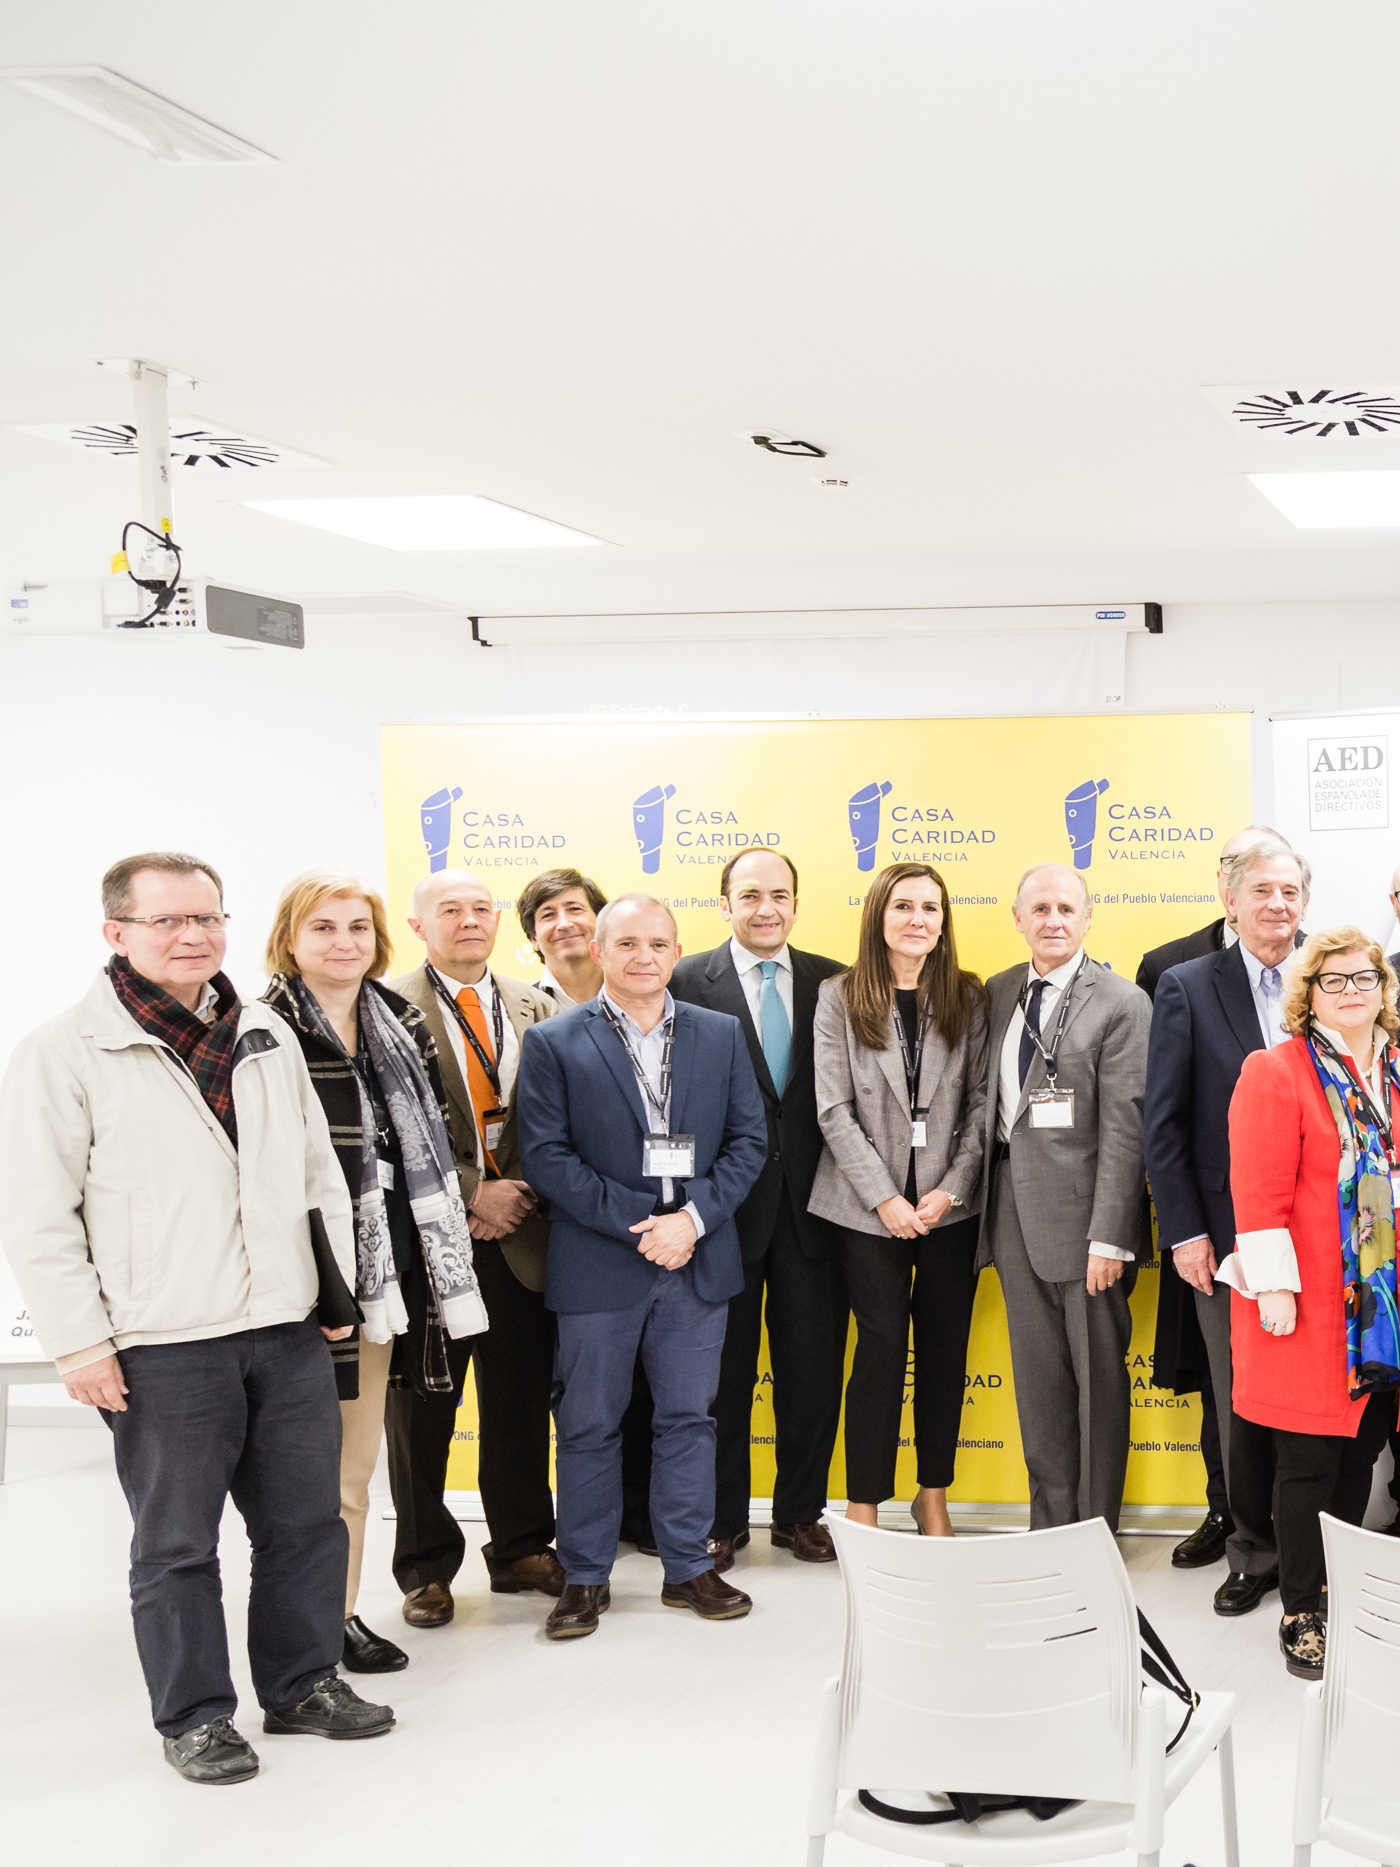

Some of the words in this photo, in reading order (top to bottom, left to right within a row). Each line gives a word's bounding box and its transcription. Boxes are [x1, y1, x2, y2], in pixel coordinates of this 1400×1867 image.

[1312, 746, 1384, 773] AED
[675, 809, 738, 825] CASA
[891, 806, 954, 822] CASA
[1108, 804, 1172, 820] CASA
[463, 811, 524, 827] CASA
[676, 831, 781, 847] CARIDAD
[891, 828, 996, 844] CARIDAD
[1108, 826, 1214, 842] CARIDAD
[463, 833, 566, 849] CARIDAD
[676, 854, 735, 865] VALEN
[891, 851, 968, 862] VALENCIA
[1108, 849, 1186, 860] VALENCIA
[463, 856, 539, 867] VALENCIA
[673, 897, 688, 908] del
[691, 897, 719, 908] Puebl
[848, 896, 861, 906] La
[950, 895, 998, 905] alenciano
[1104, 894, 1119, 903] del
[1122, 893, 1157, 903] Pueblo
[1160, 892, 1216, 903] Valenciano
[956, 1439, 1004, 1448] alenciano
[1164, 1441, 1200, 1452] Valenci
